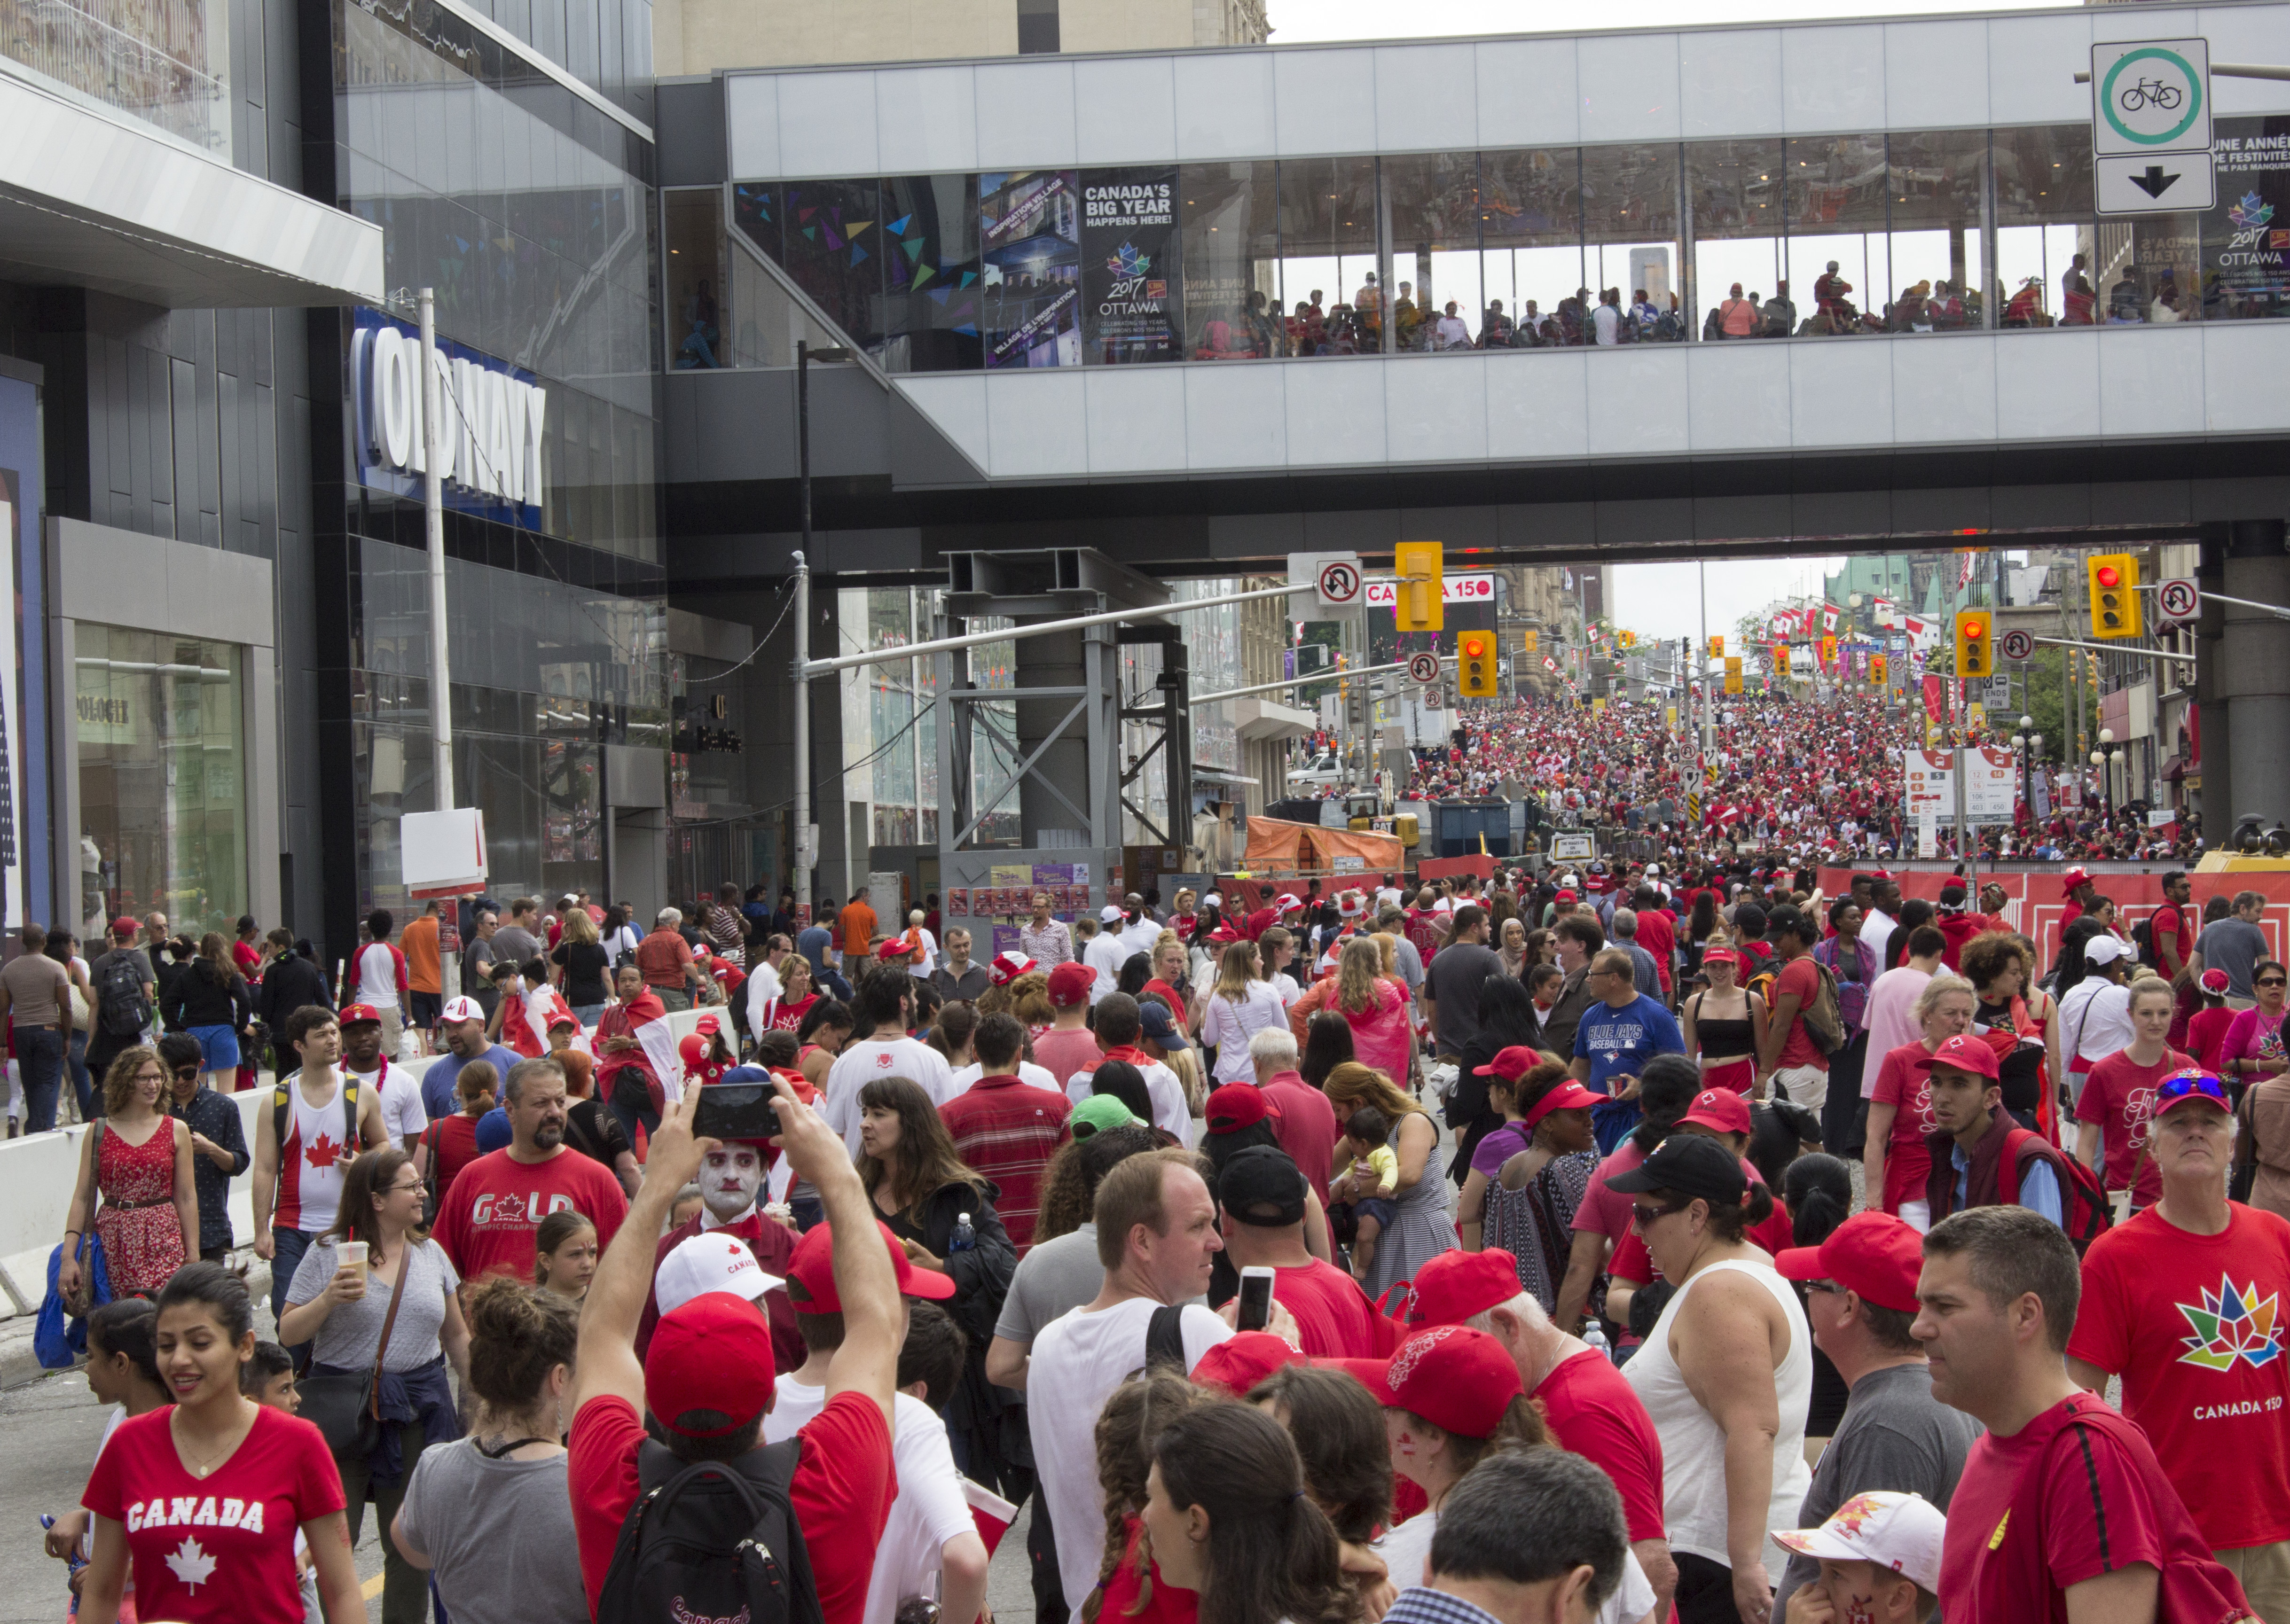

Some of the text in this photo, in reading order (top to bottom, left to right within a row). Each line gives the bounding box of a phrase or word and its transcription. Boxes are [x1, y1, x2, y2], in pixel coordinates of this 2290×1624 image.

[1085, 184, 1170, 201] CANADA'S
[988, 178, 1063, 238] INSPIRATION VILLAGE
[1086, 199, 1170, 216] BIG YEAR
[1087, 215, 1172, 227] HAPPENS HERE!
[2228, 226, 2269, 250] 2017
[2219, 252, 2283, 266] OTTAWA
[1107, 276, 1146, 300] 2017
[1099, 302, 1160, 315] OTTAWA
[994, 288, 1077, 354] VILLAGE DE L'INSPIRATION
[374, 327, 456, 478] OLD
[454, 358, 546, 507] NAVY
[1368, 581, 1450, 601] CAA
[1373, 822, 1393, 834] CAT
[1588, 1023, 1643, 1041] BLUE JAYS
[1589, 1039, 1619, 1050] BASEBALL
[2193, 1396, 2283, 1420] CANADA 150
[127, 1497, 264, 1534] CANADA
